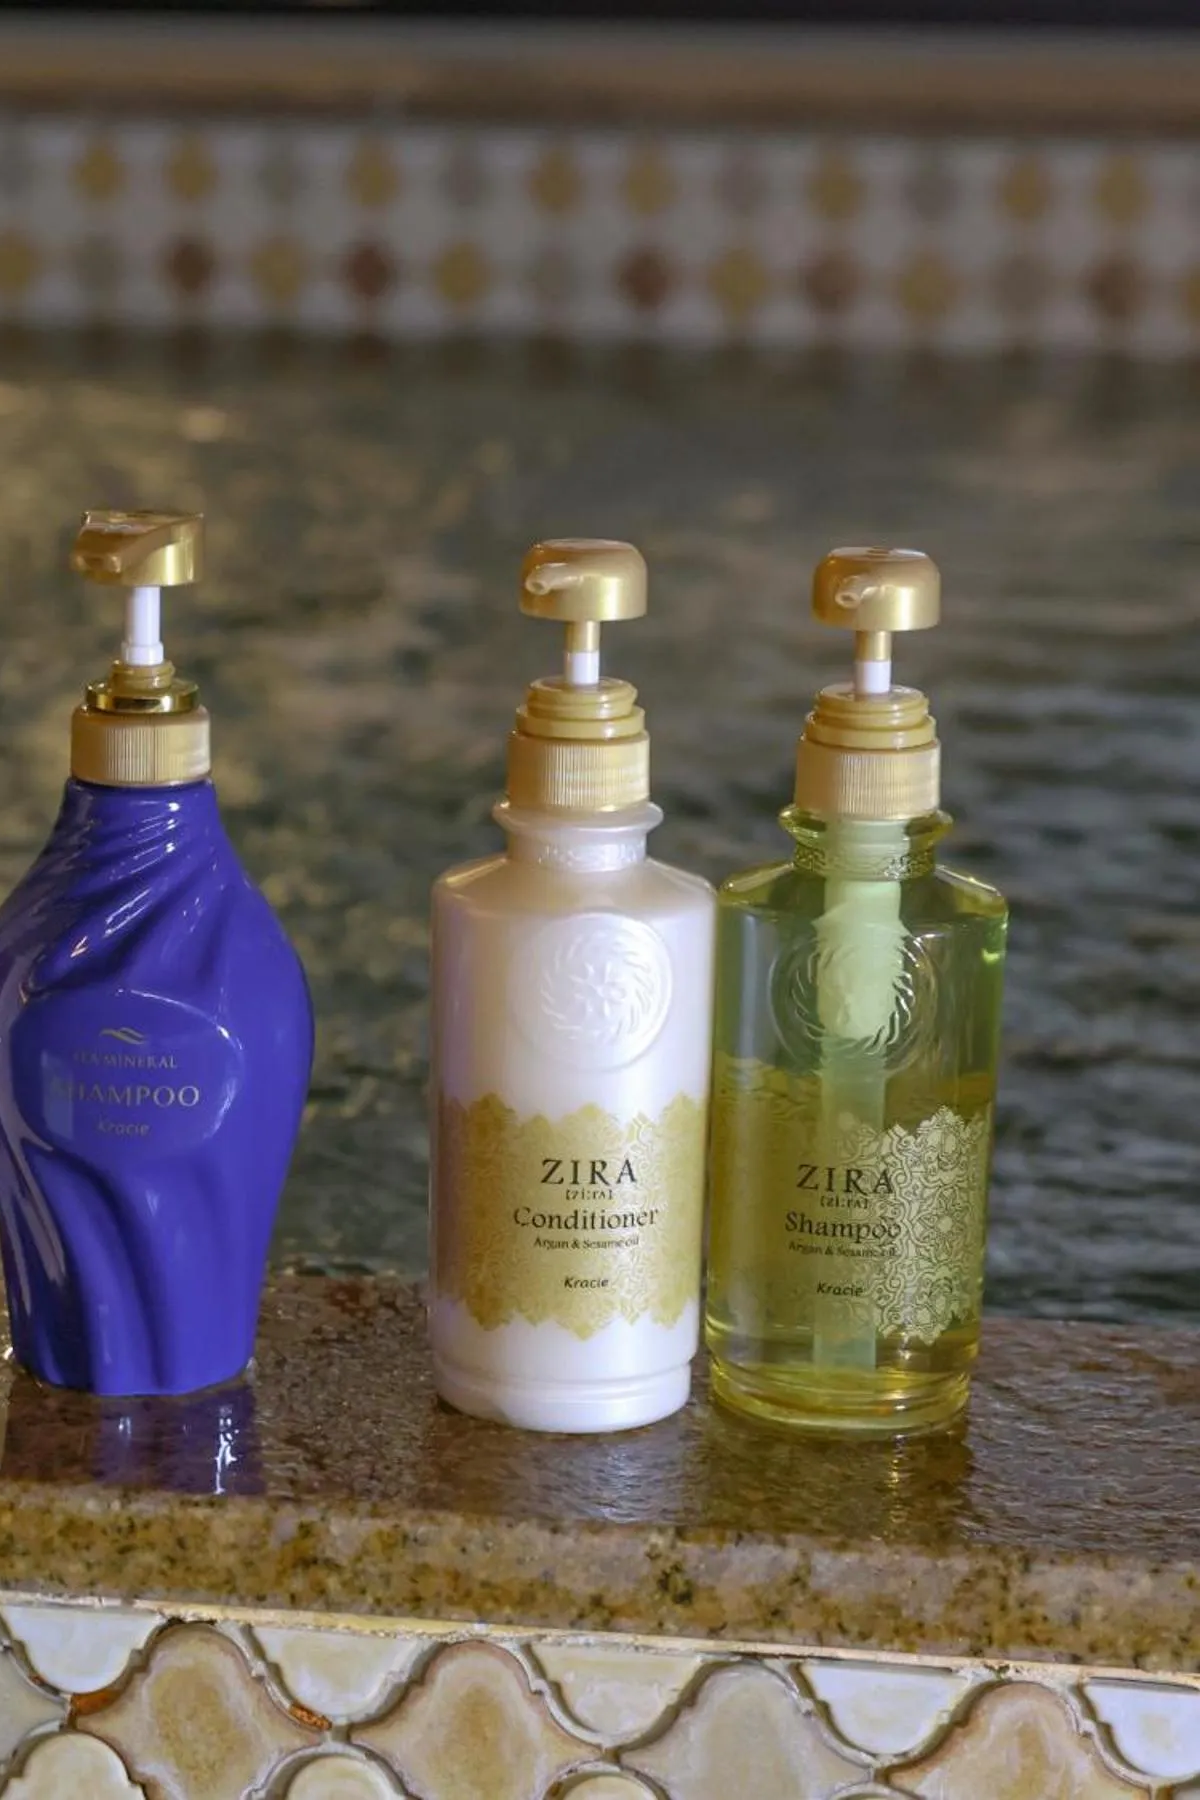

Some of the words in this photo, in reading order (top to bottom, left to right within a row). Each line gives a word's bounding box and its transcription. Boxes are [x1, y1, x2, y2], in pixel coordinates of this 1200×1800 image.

[104, 1054, 177, 1068] MINERAL
[98, 1120, 150, 1136] Kracie
[540, 1158, 637, 1186] ZIRA
[796, 1164, 894, 1195] ZIRA
[513, 1206, 657, 1230] Conditioner
[785, 1211, 901, 1243] Shampoo
[564, 1277, 609, 1289] Kracie
[816, 1282, 864, 1297] Kracie
